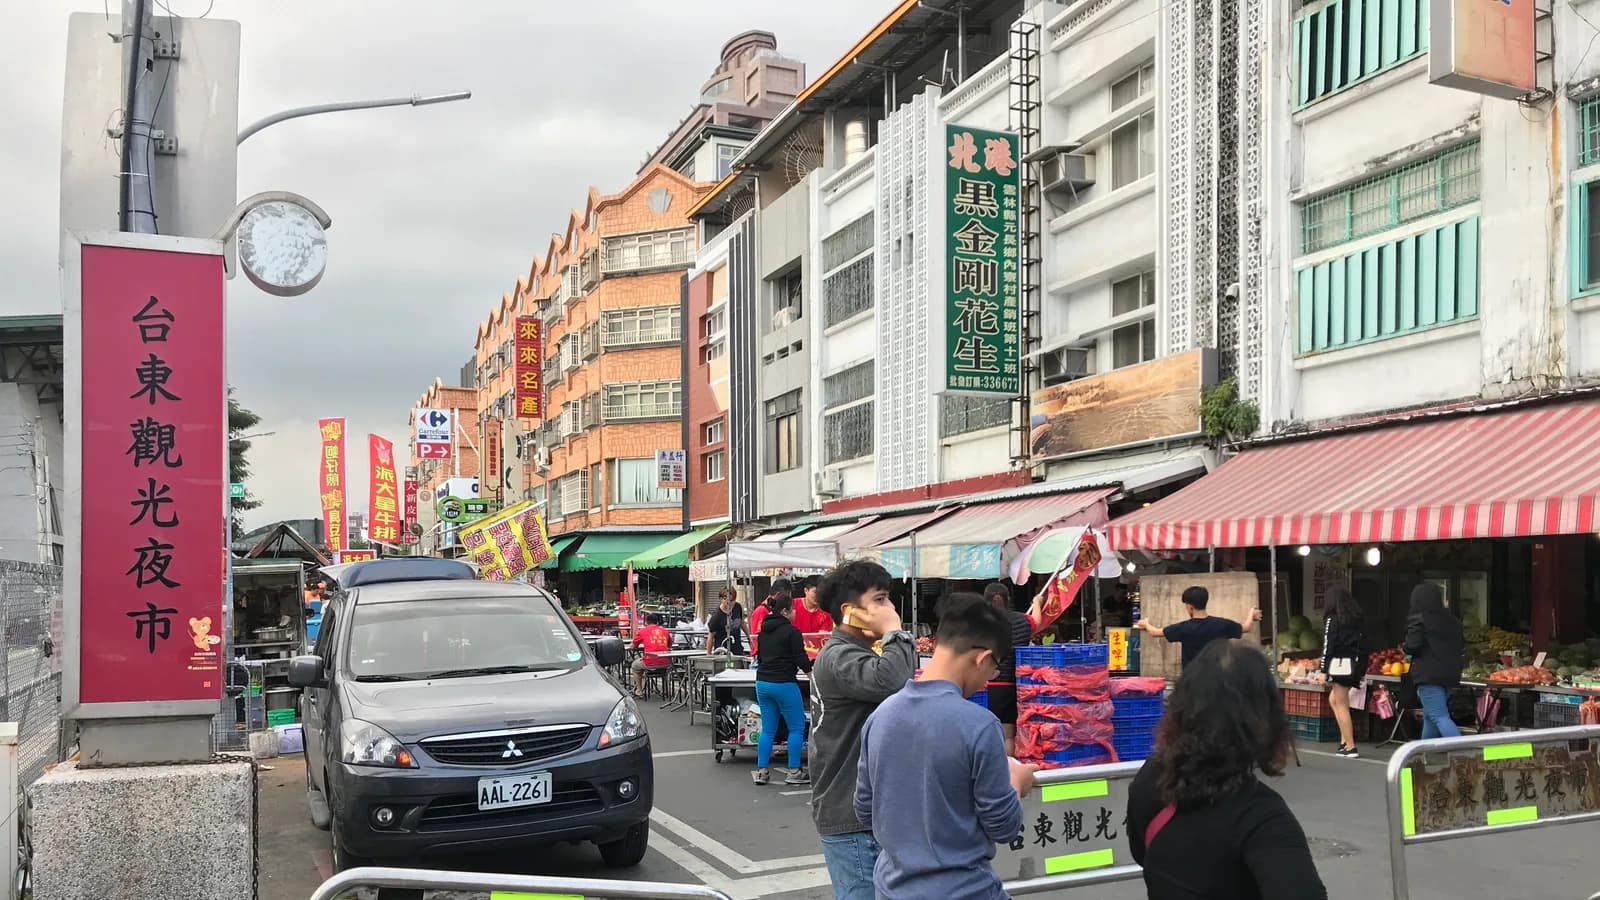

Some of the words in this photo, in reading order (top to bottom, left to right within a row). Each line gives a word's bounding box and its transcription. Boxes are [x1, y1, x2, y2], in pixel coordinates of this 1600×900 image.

[948, 132, 1017, 176] 北港
[953, 177, 999, 372] 黑金剛花生
[521, 321, 538, 414] 來來名產
[126, 296, 182, 654] 台東觀光夜市
[420, 444, 432, 457] P
[374, 466, 397, 540] 派大星牛排
[480, 780, 548, 805] AAL-2261
